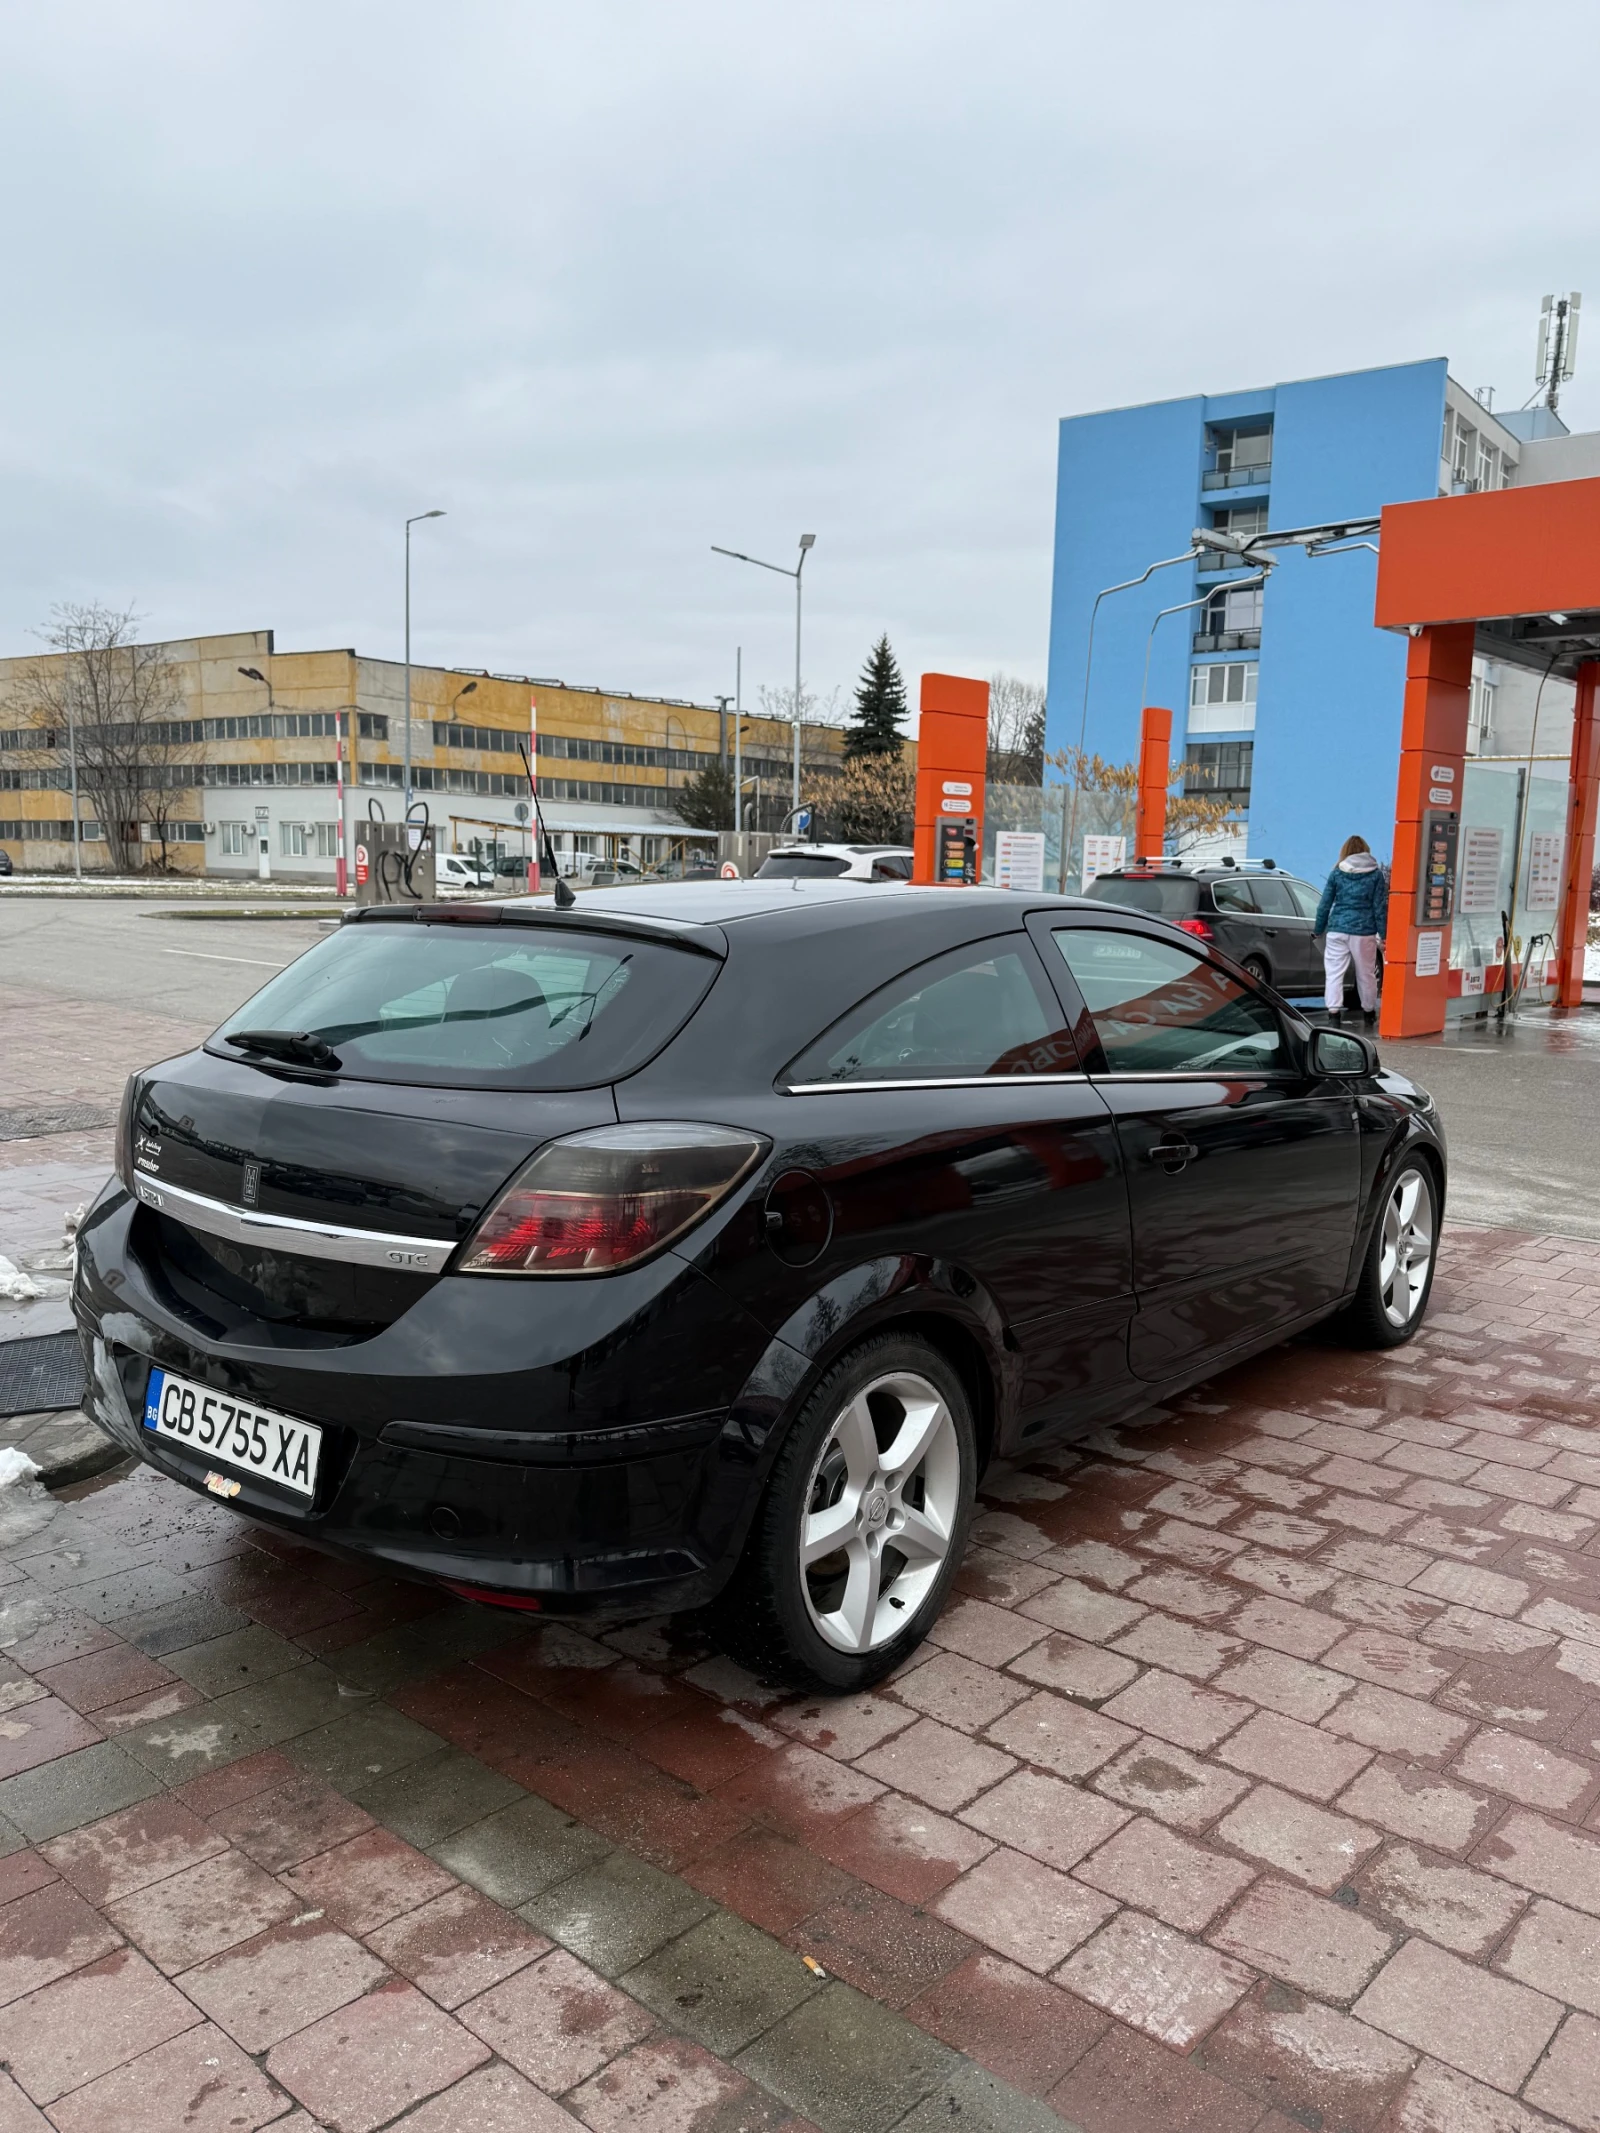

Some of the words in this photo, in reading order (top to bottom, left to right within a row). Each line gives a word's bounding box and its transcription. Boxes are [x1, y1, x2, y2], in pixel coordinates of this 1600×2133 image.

[385, 1250, 428, 1266] GTC
[147, 1405, 158, 1421] BG
[162, 1384, 196, 1436] CB
[198, 1396, 270, 1465] 5755
[271, 1424, 310, 1486] XA
